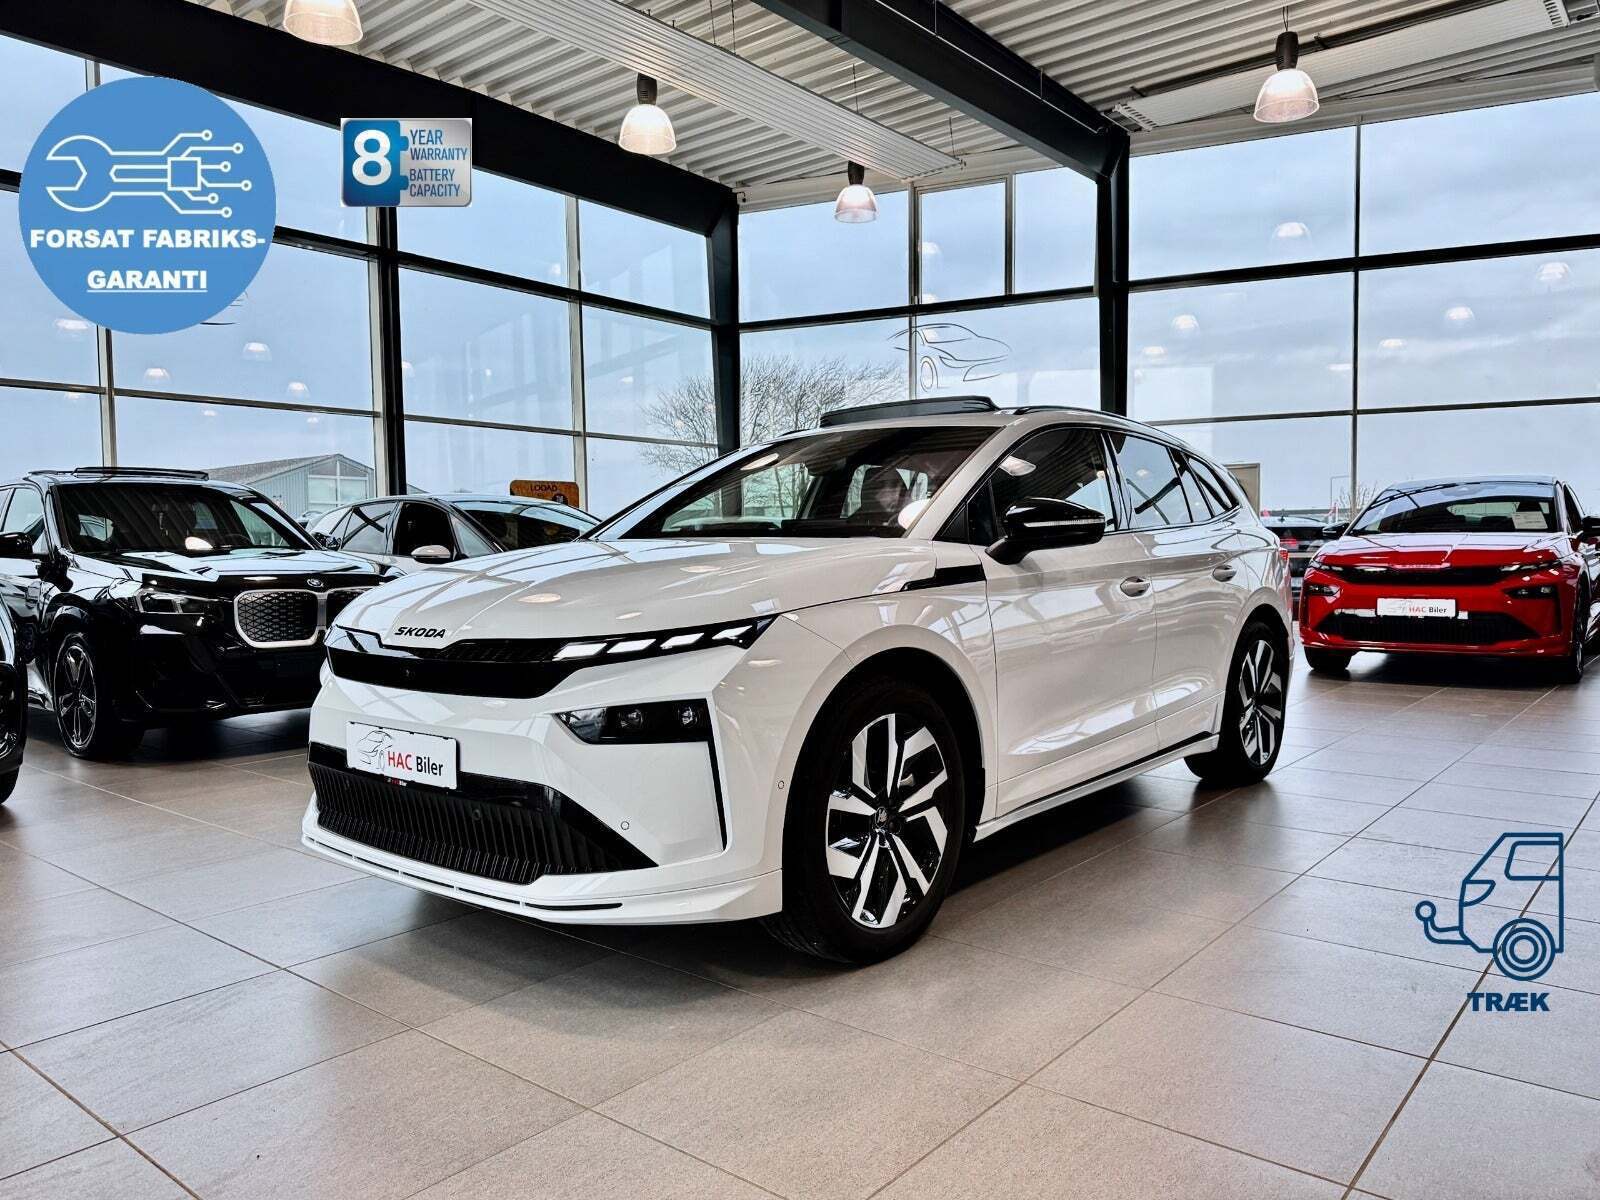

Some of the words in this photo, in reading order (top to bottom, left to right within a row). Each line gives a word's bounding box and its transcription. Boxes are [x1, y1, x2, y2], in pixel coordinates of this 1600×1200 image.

[1428, 606, 1448, 614] Biler
[387, 750, 413, 771] HAC
[416, 755, 444, 777] Biler
